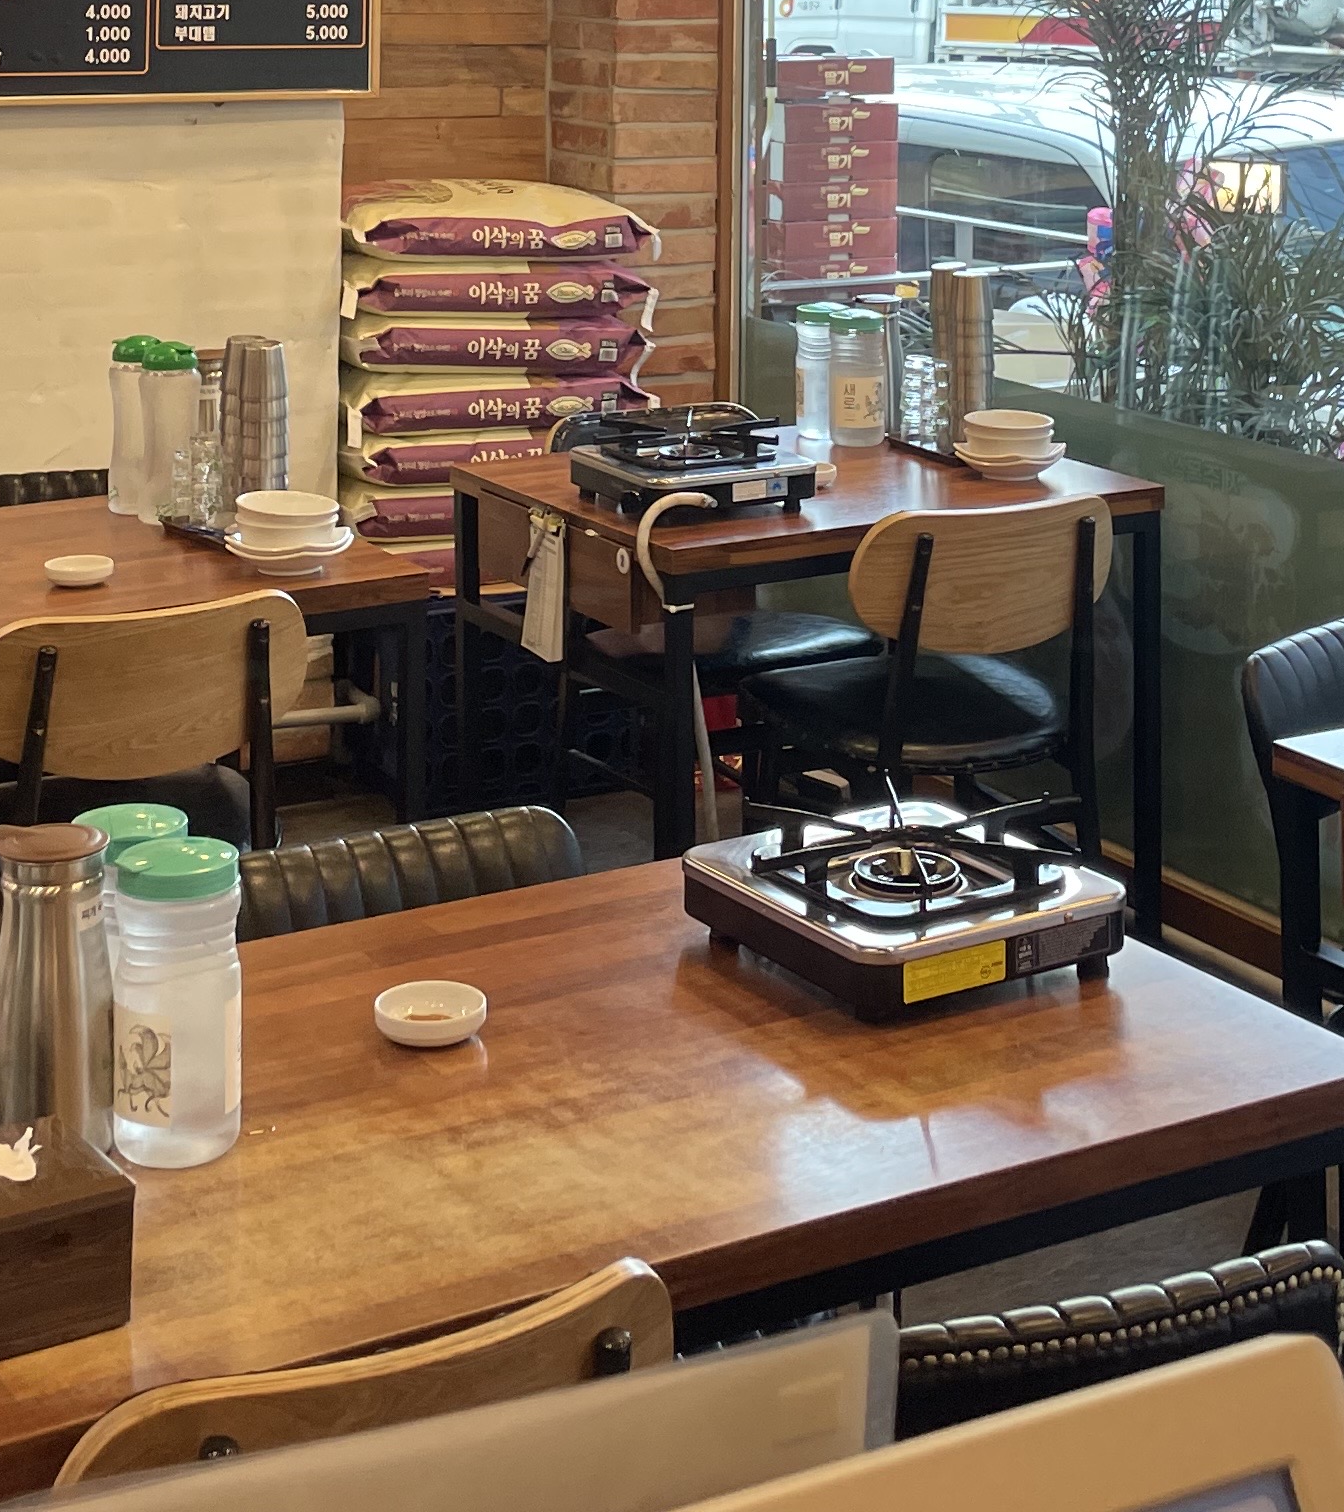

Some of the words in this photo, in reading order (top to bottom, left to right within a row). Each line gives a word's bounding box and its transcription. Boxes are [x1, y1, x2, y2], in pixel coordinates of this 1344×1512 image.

[85, 4, 131, 20] 4,000
[306, 3, 349, 20] 5,000
[85, 26, 131, 43] 1,000
[305, 24, 349, 41] 5,000
[84, 48, 131, 65] 4,000
[472, 226, 524, 249] 이삭의
[527, 228, 546, 250] 꿈
[468, 281, 518, 305] 이삭의
[522, 282, 542, 305] 꿈
[467, 337, 518, 361] 이삭의
[523, 339, 542, 361] 꿈
[467, 395, 520, 420] 이삭의
[522, 400, 543, 419] 꿈
